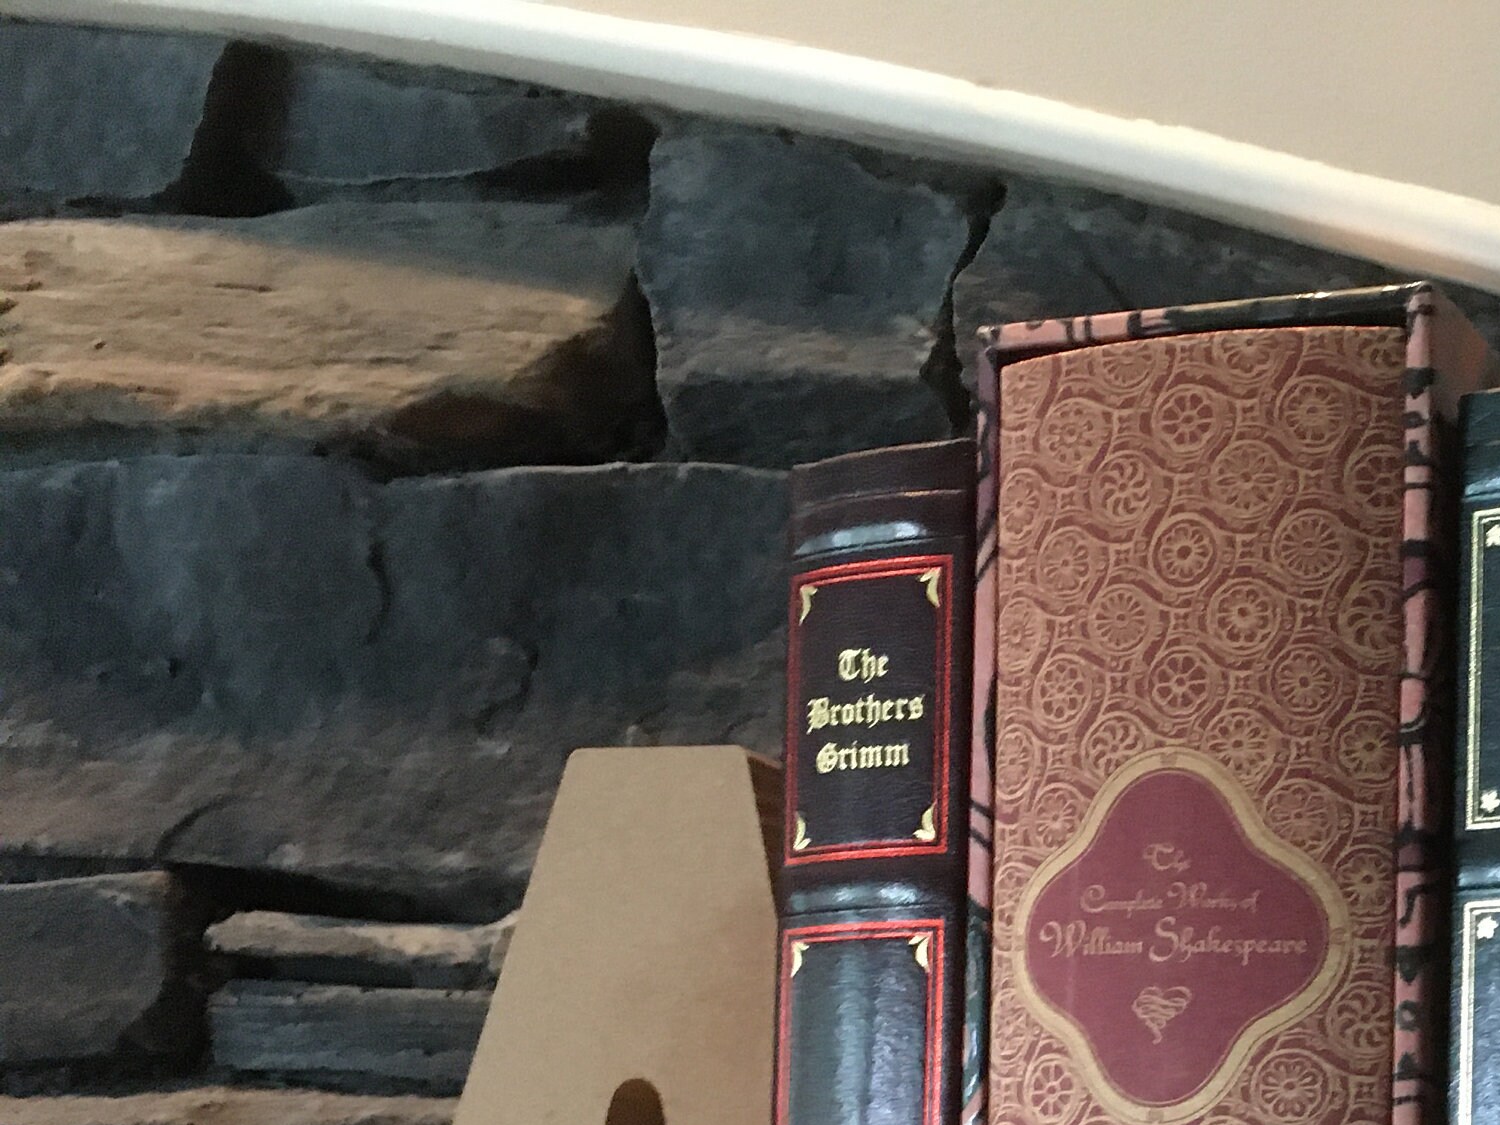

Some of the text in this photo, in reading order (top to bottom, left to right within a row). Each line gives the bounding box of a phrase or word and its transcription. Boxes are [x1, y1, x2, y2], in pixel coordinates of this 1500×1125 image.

[838, 648, 890, 683] The
[806, 693, 926, 735] Brothers
[816, 740, 911, 775] Grimm
[1039, 916, 1308, 966] William Shakespeare
